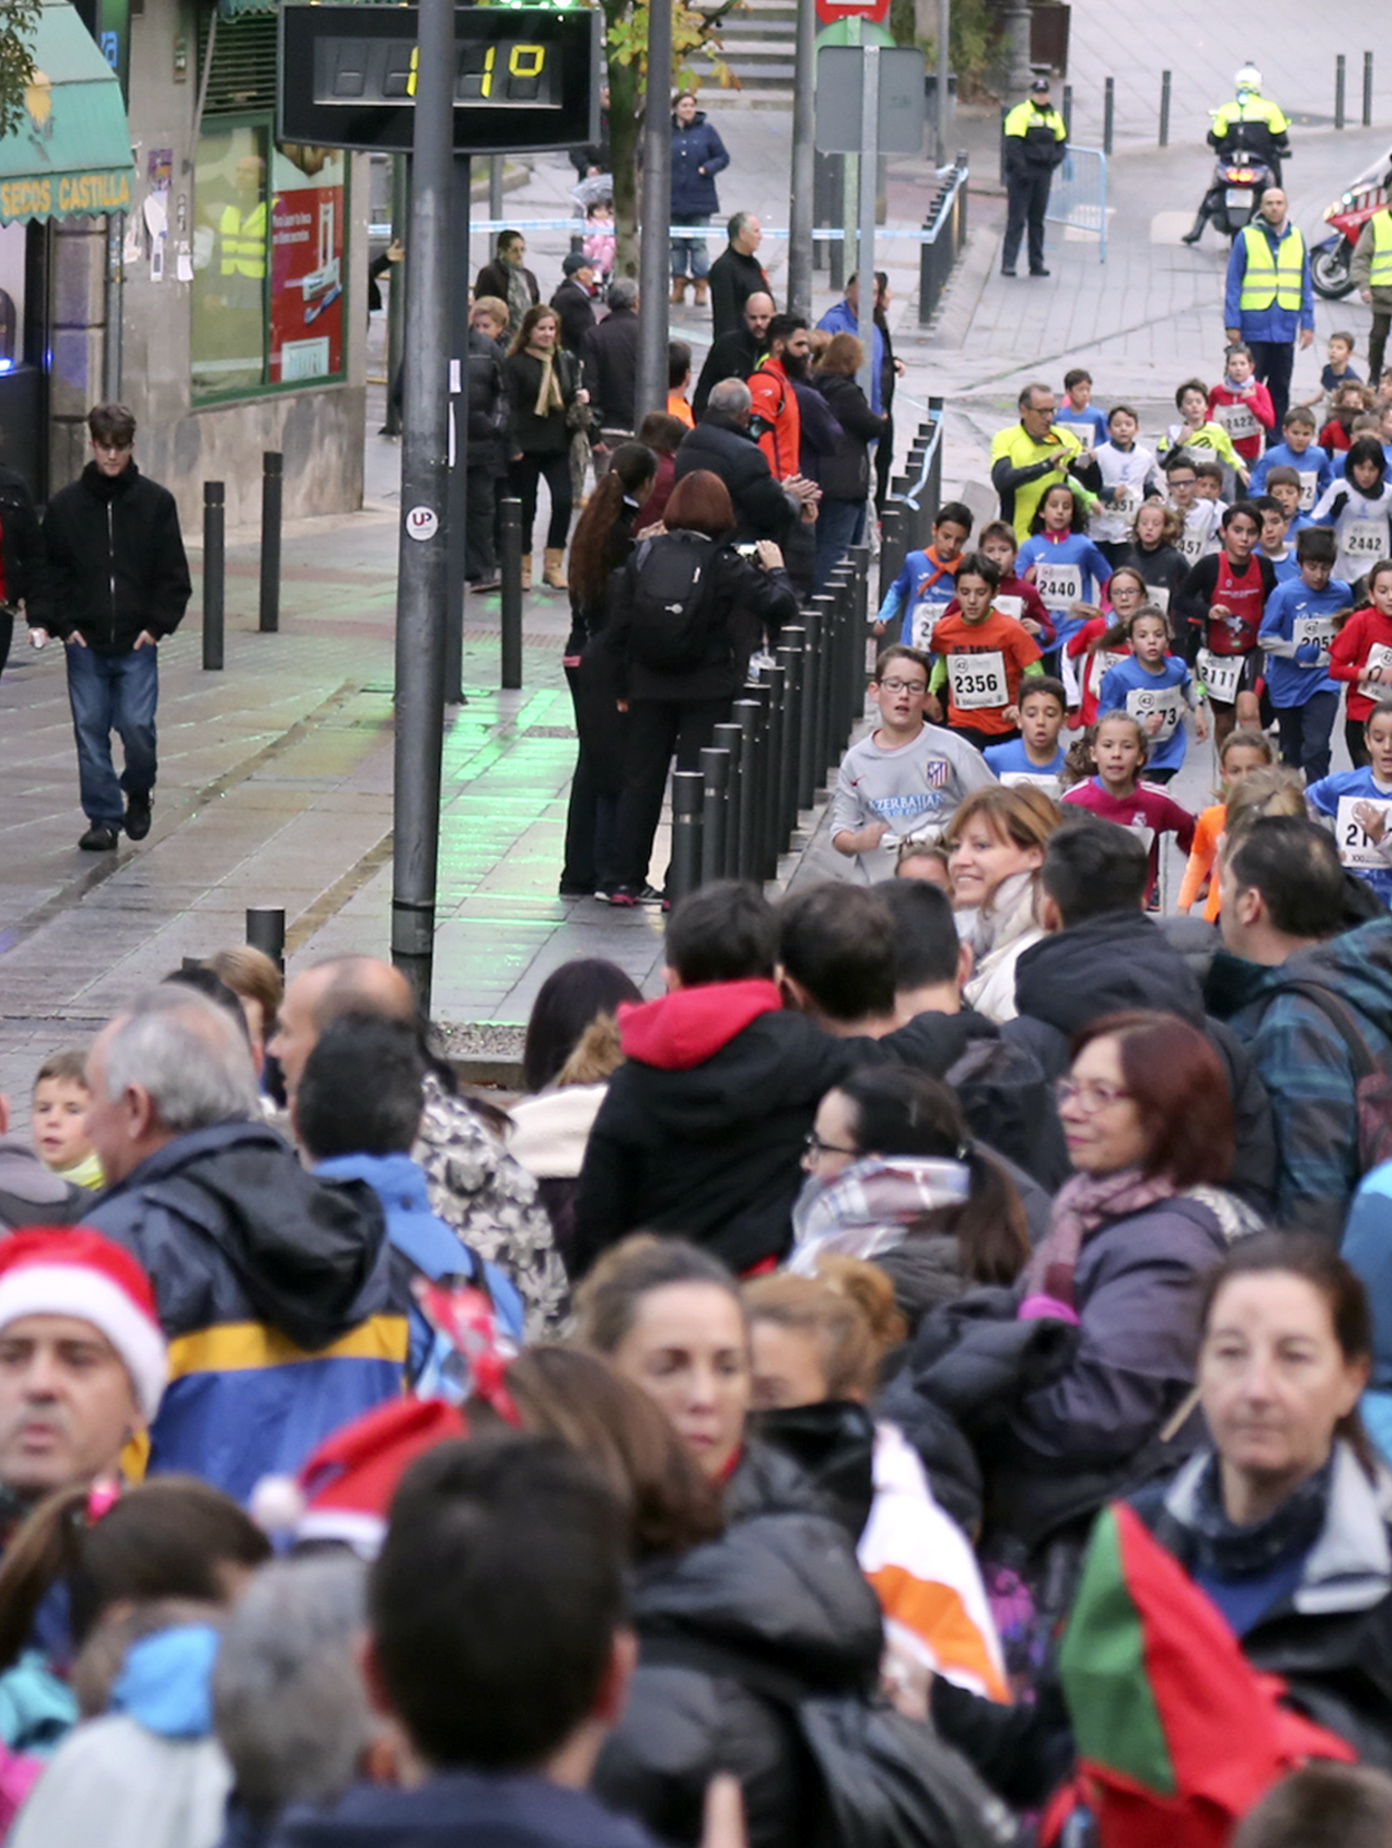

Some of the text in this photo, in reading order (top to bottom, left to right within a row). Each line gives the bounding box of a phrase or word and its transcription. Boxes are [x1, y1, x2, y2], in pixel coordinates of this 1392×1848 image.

[58, 174, 130, 211] CASTILLA
[1226, 415, 1254, 429] 2422
[412, 512, 432, 527] UP
[1180, 540, 1202, 555] 457
[1349, 536, 1382, 551] 2442
[1039, 580, 1076, 597] 2440
[1301, 635, 1336, 652] 205
[955, 673, 998, 694] 2356
[1201, 666, 1235, 687] 2111
